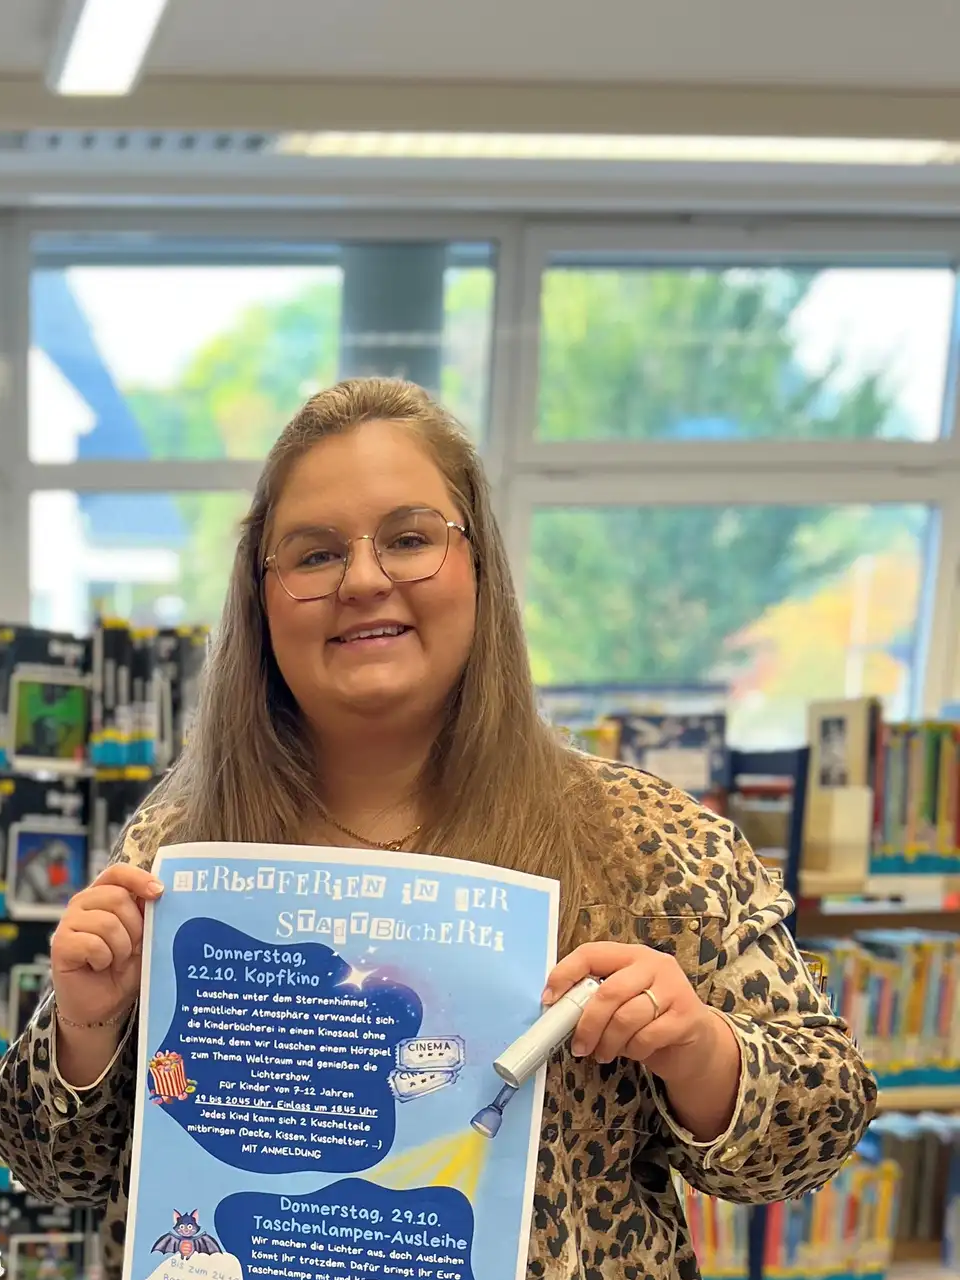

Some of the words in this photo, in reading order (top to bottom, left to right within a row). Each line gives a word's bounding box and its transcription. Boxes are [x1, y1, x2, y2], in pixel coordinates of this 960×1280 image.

[203, 943, 307, 968] Donnerstag,
[187, 965, 237, 982] 22.10.
[244, 966, 320, 987] Kopfkino
[196, 989, 239, 1000] Lauschen
[242, 993, 269, 1002] unter
[272, 993, 292, 1003] dem
[295, 995, 368, 1008] Sternenhimmel
[192, 1005, 248, 1016] gemütlicher
[251, 1008, 310, 1020] Atmosphäre
[313, 1013, 372, 1024] verwandelt
[375, 1016, 395, 1025] sich
[187, 1019, 201, 1028] die
[204, 1019, 275, 1033] Kinderbücherei
[289, 1027, 314, 1035] einen
[318, 1027, 359, 1039] Kinosaal
[362, 1030, 386, 1040] ohne
[228, 1037, 251, 1046] denn
[274, 1040, 316, 1051] lauschen
[319, 1044, 347, 1053] einem
[350, 1046, 391, 1057] Hörspiel
[407, 1042, 451, 1052] CINEMA
[190, 1052, 209, 1060] zum
[212, 1051, 242, 1062] Thema
[246, 1054, 293, 1065] Weltraum
[296, 1058, 313, 1067] und
[316, 1060, 360, 1070] genießen
[363, 1062, 378, 1072] die
[219, 1081, 237, 1089] Für
[239, 1081, 270, 1092] Kinder
[274, 1086, 290, 1094] von
[293, 1086, 316, 1096] 7-12
[320, 1088, 354, 1098] Jahren
[209, 1095, 222, 1104] bis
[277, 1100, 311, 1110] Einlass
[314, 1104, 327, 1112] um
[359, 1107, 378, 1116] Uhr
[187, 1124, 236, 1136] mitbringen
[200, 1109, 226, 1120] Jedes
[229, 1111, 250, 1122] Kind
[253, 1113, 275, 1123] kann
[278, 1116, 297, 1125] sich
[310, 1118, 371, 1132] Kuschelteile
[241, 1144, 258, 1154] MIT
[260, 1145, 322, 1159] ANMELDUNG
[280, 1196, 384, 1224] Donnerstag,
[391, 1208, 441, 1227] 29.10.
[253, 1215, 468, 1250] Taschenlampen-Ausleihe
[251, 1235, 268, 1245] Wir
[271, 1238, 307, 1249] machen
[310, 1241, 325, 1251] die
[327, 1243, 364, 1255] Lichter
[389, 1250, 413, 1260] doch
[246, 1265, 312, 1280] Taschenlampe
[251, 1249, 279, 1261] könnt
[282, 1253, 296, 1263] Ihr
[350, 1261, 380, 1272] Dafür
[383, 1265, 415, 1278] bringt
[418, 1268, 433, 1277] Ihr
[436, 1270, 461, 1280] Eure
